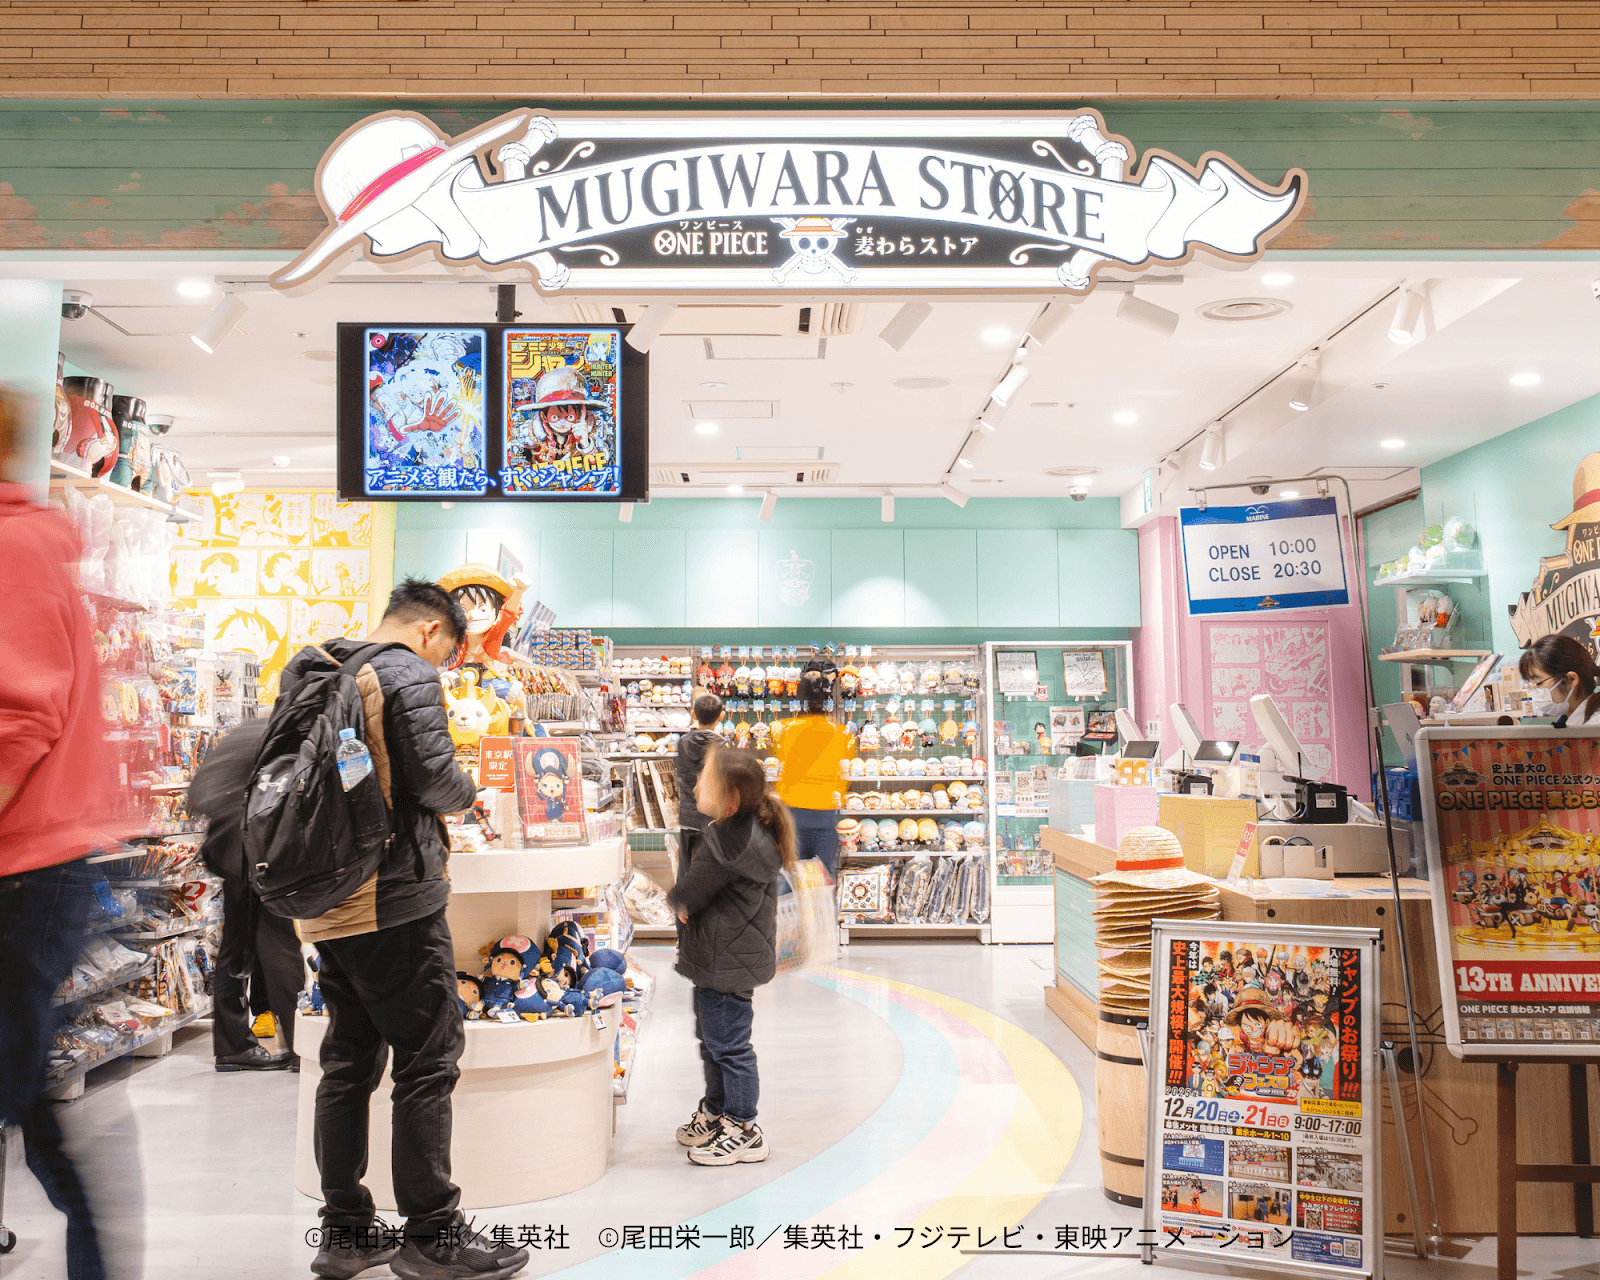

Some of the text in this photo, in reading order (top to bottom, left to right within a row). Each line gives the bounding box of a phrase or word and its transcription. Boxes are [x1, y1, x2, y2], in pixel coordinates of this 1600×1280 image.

[535, 149, 1105, 243] MUGIWARA STORE
[679, 221, 742, 231] ワンピース
[654, 230, 768, 256] ONE PIECE
[854, 236, 979, 256] 麦わらストア
[1246, 513, 1270, 522] MARINE
[1582, 525, 1600, 538] ワンピ
[1209, 538, 1316, 560] OPEN 10:00
[1209, 560, 1322, 582] CLOSE 20:30
[488, 761, 508, 771] 限定
[1491, 763, 1547, 774] 史上最大の
[1492, 775, 1522, 786] ONE
[1526, 775, 1560, 786] PIECE
[1437, 789, 1600, 811] ONE PIECE 麦わら
[1188, 941, 1199, 969] 今年は
[1456, 966, 1514, 992] 13TH
[1460, 1005, 1480, 1014] ONE
[1482, 1005, 1509, 1014] PIECE
[1229, 1055, 1294, 1076] ジャンプ
